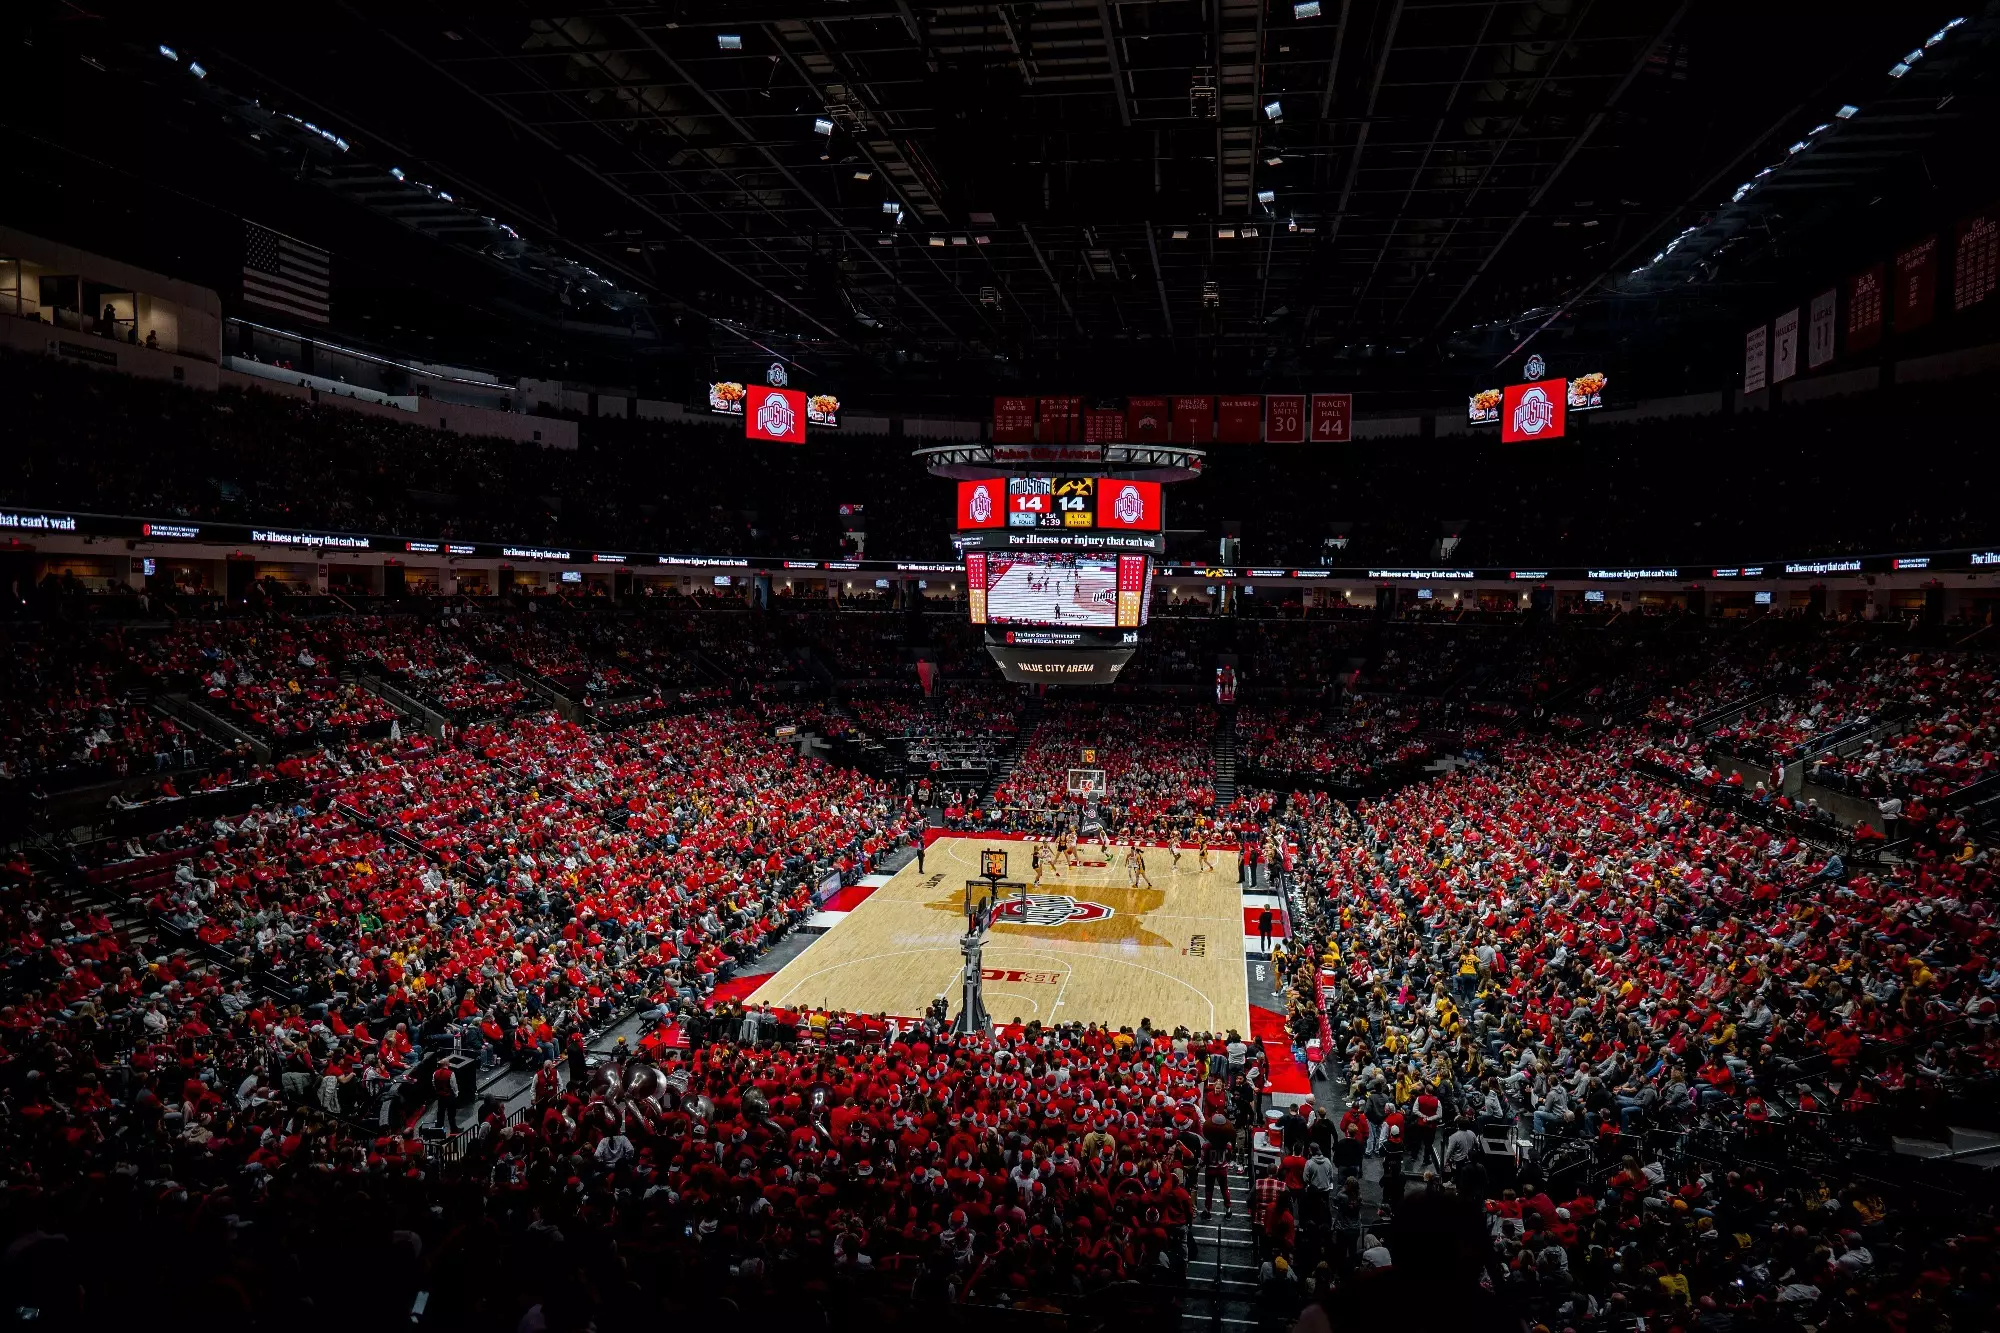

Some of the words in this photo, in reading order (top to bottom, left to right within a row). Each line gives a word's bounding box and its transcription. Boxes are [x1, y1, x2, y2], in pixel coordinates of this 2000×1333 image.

[1817, 322, 1828, 350] 11
[1781, 339, 1788, 361] 5
[1274, 417, 1297, 432] 30
[1318, 419, 1343, 436] 44
[1017, 496, 1043, 511] 14
[1058, 496, 1085, 511] 14
[20, 515, 49, 528] can't
[50, 517, 76, 531] wait
[252, 531, 266, 541] For
[267, 531, 292, 543] illness
[293, 535, 302, 544] or
[302, 533, 324, 547] injury
[324, 535, 339, 546] that
[339, 536, 355, 546] can't
[355, 538, 369, 548] wait
[1009, 535, 1025, 544] For
[1025, 534, 1059, 544] illness
[1074, 535, 1105, 547] injury
[1106, 536, 1125, 546] that
[1126, 537, 1143, 547] can't
[1970, 554, 1984, 565] For
[955, 564, 966, 572] tha
[1163, 568, 1173, 576] 14
[1380, 570, 1401, 578] illness
[1410, 570, 1431, 579] injury
[1431, 570, 1445, 578] that
[1461, 571, 1474, 579] wait
[1588, 570, 1598, 578] For
[1623, 570, 1639, 579] injury
[1639, 569, 1651, 577] that
[1651, 569, 1664, 577] can't
[1664, 569, 1678, 577] wait
[1785, 564, 1794, 573] For
[1017, 662, 1043, 672] VALUE
[1045, 664, 1066, 673] CITY
[1066, 663, 1095, 673] ARENA
